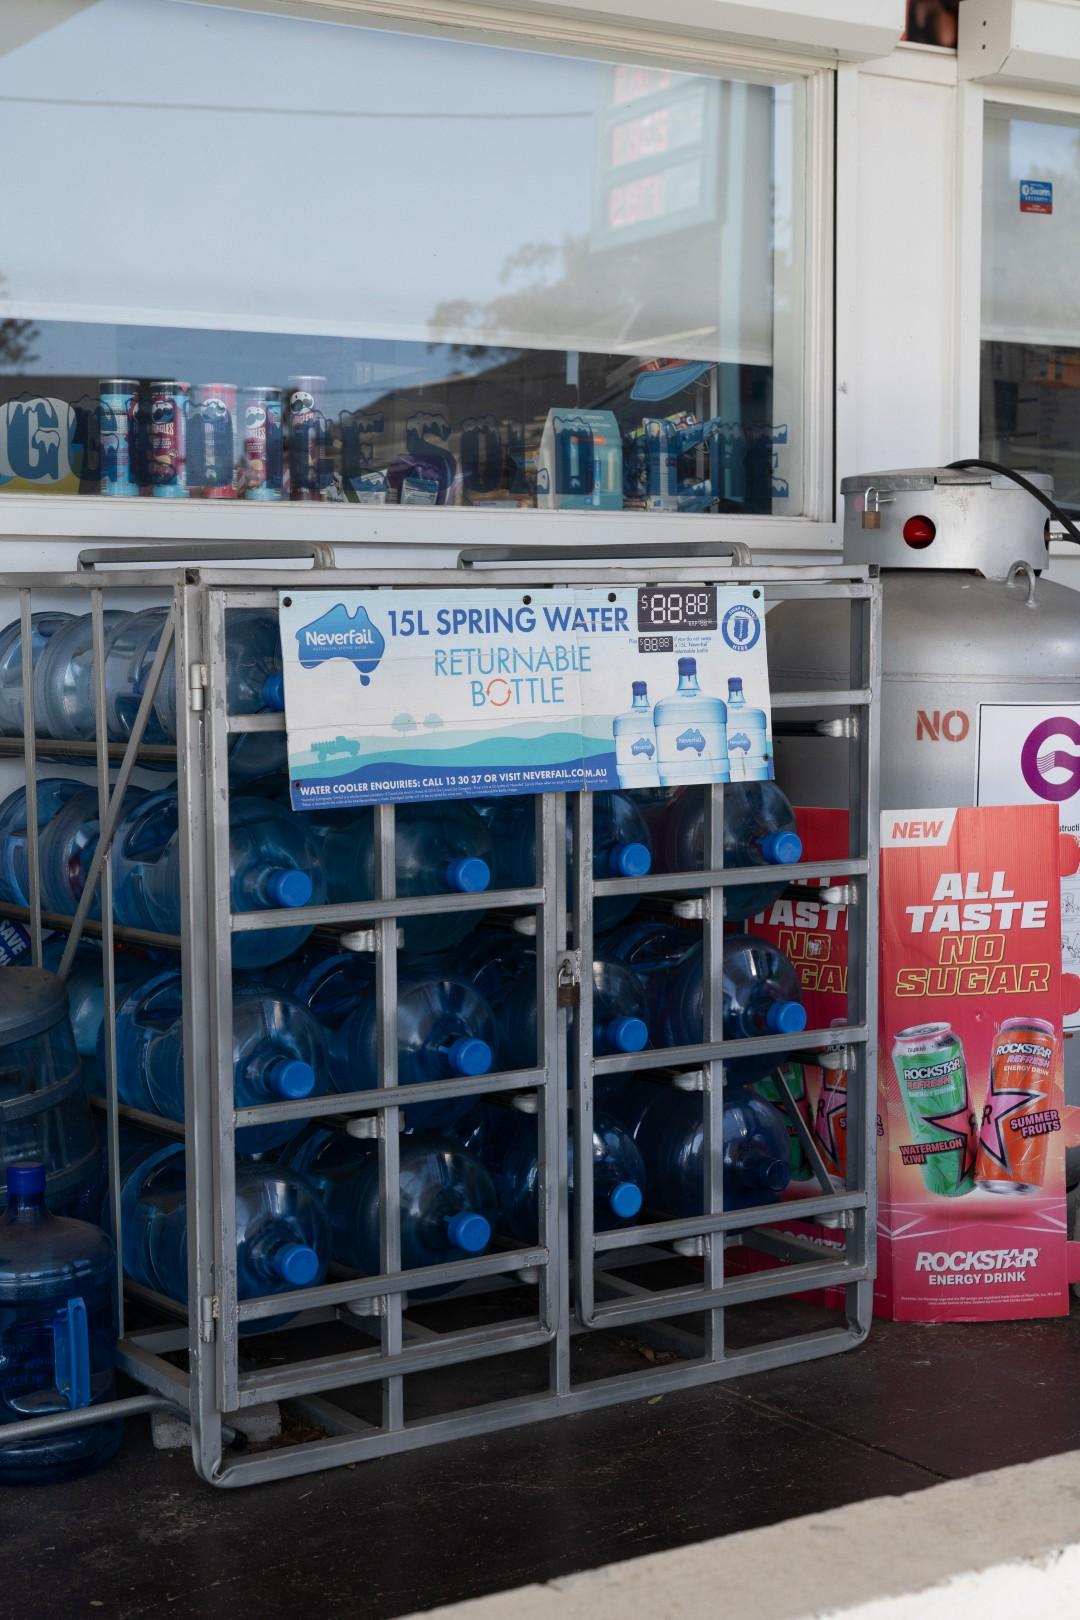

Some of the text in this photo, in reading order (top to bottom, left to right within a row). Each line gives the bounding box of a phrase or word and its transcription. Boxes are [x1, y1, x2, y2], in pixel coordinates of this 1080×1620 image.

[388, 606, 630, 637] 15L SPRING WATER
[305, 629, 375, 646] Neverfail
[434, 645, 592, 677] RETURNABLE
[471, 677, 564, 707] BOTTLE
[916, 710, 970, 743] NO
[300, 768, 607, 796] WATER COOLER ENQUIRIES: CALL 13 30 37 OR VISIT NEVERFAIL.COM.AU
[891, 819, 944, 840] NEW
[933, 871, 1015, 901] ALL
[905, 900, 1049, 933] TASTE
[939, 933, 1005, 965] NO
[895, 963, 1051, 997] SUGAR
[997, 1042, 1052, 1059] ROCKSTAR
[1007, 1054, 1051, 1068] REFRESH
[903, 1057, 961, 1081] ROCKSTAR
[1004, 1065, 1049, 1077] ENERGY DRINK
[1010, 1111, 1059, 1131] SUMMER
[1022, 1120, 1061, 1137] FRUITS
[900, 1138, 963, 1156] WATERMELON
[902, 1152, 926, 1166] KIWI
[915, 1247, 1040, 1272] ROCKSTAR
[928, 1271, 1026, 1285] ENERGY DRINK
